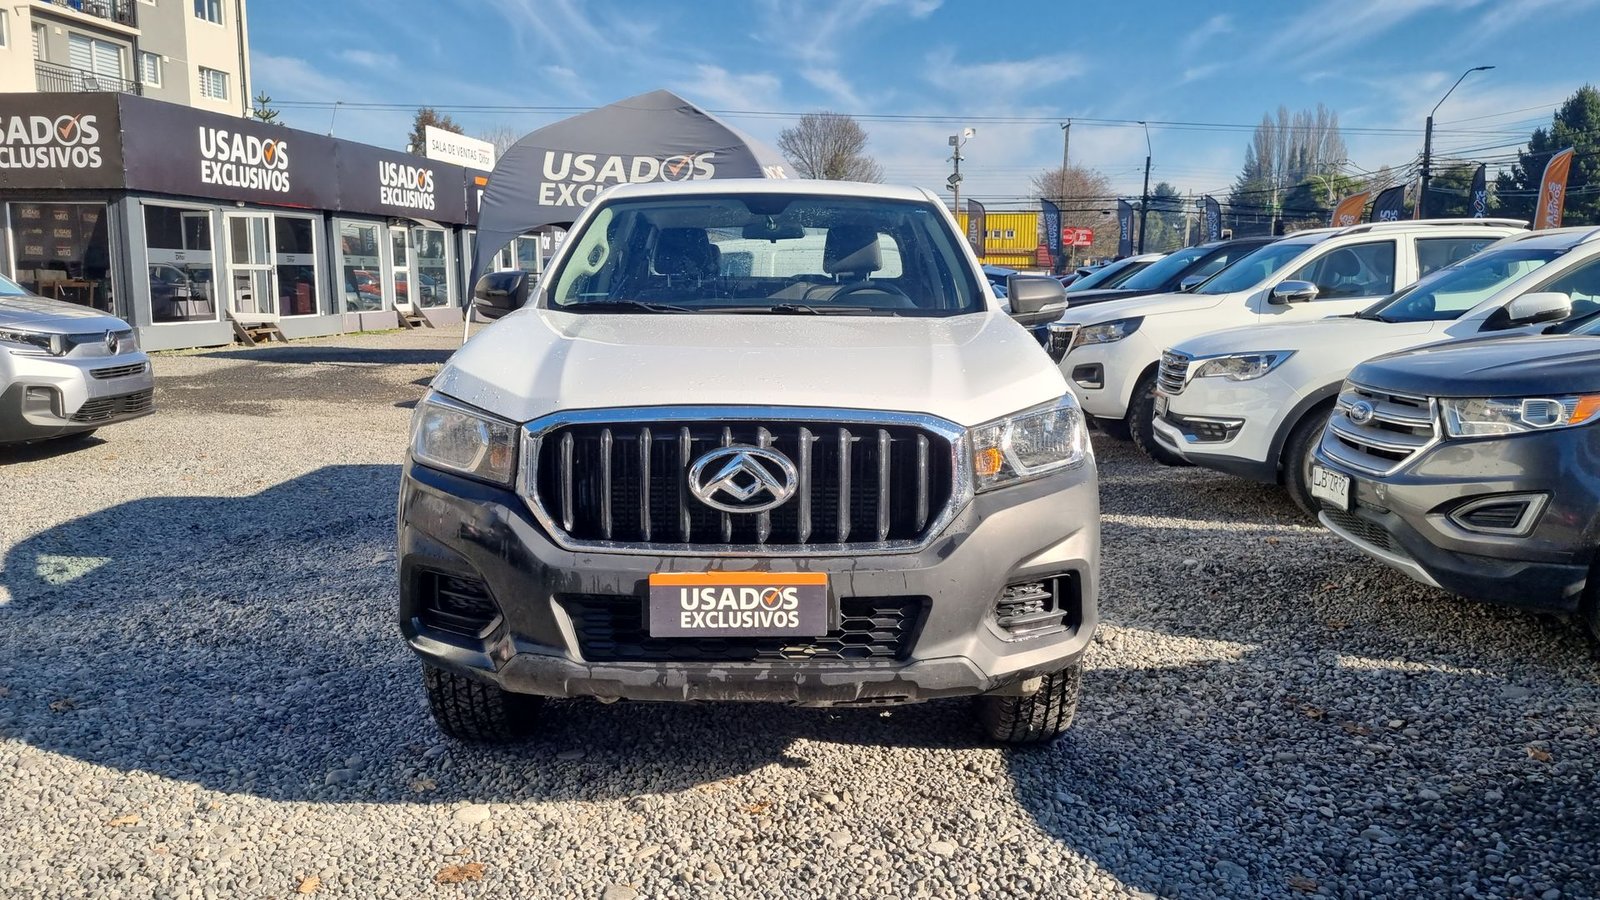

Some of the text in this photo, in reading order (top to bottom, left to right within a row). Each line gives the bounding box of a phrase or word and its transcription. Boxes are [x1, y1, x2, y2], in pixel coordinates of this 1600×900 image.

[199, 126, 289, 170] USADOS
[432, 139, 477, 161] SALA DE VENTAS
[201, 160, 290, 193] EXCLUSIVOS
[379, 160, 434, 193] USADOS
[543, 151, 716, 183] USADOS
[380, 186, 435, 211] EXCLUSIVOS
[680, 587, 799, 611] USADOS
[680, 611, 800, 629] EXCLUSIVOS
